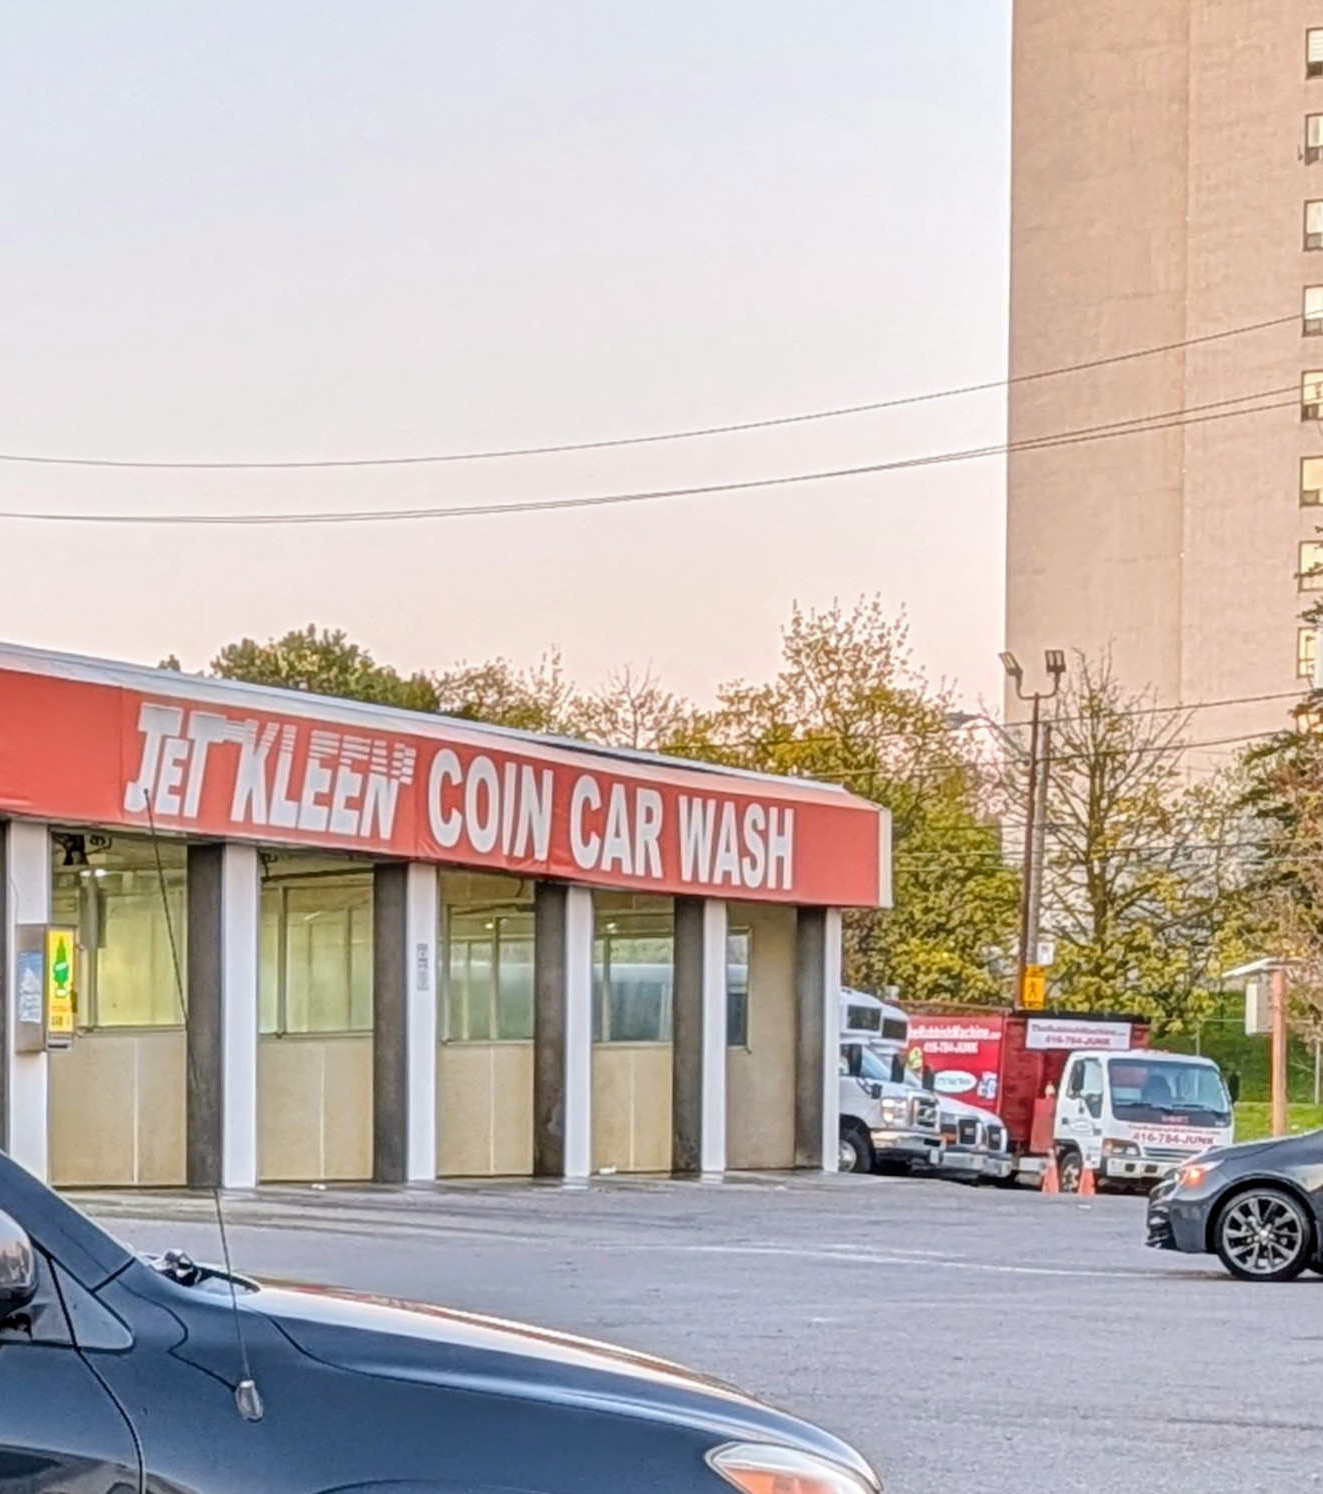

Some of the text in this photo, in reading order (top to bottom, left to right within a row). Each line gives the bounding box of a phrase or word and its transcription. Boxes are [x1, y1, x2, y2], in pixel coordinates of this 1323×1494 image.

[123, 702, 795, 891] JET KLEEN COIN CAR WASH
